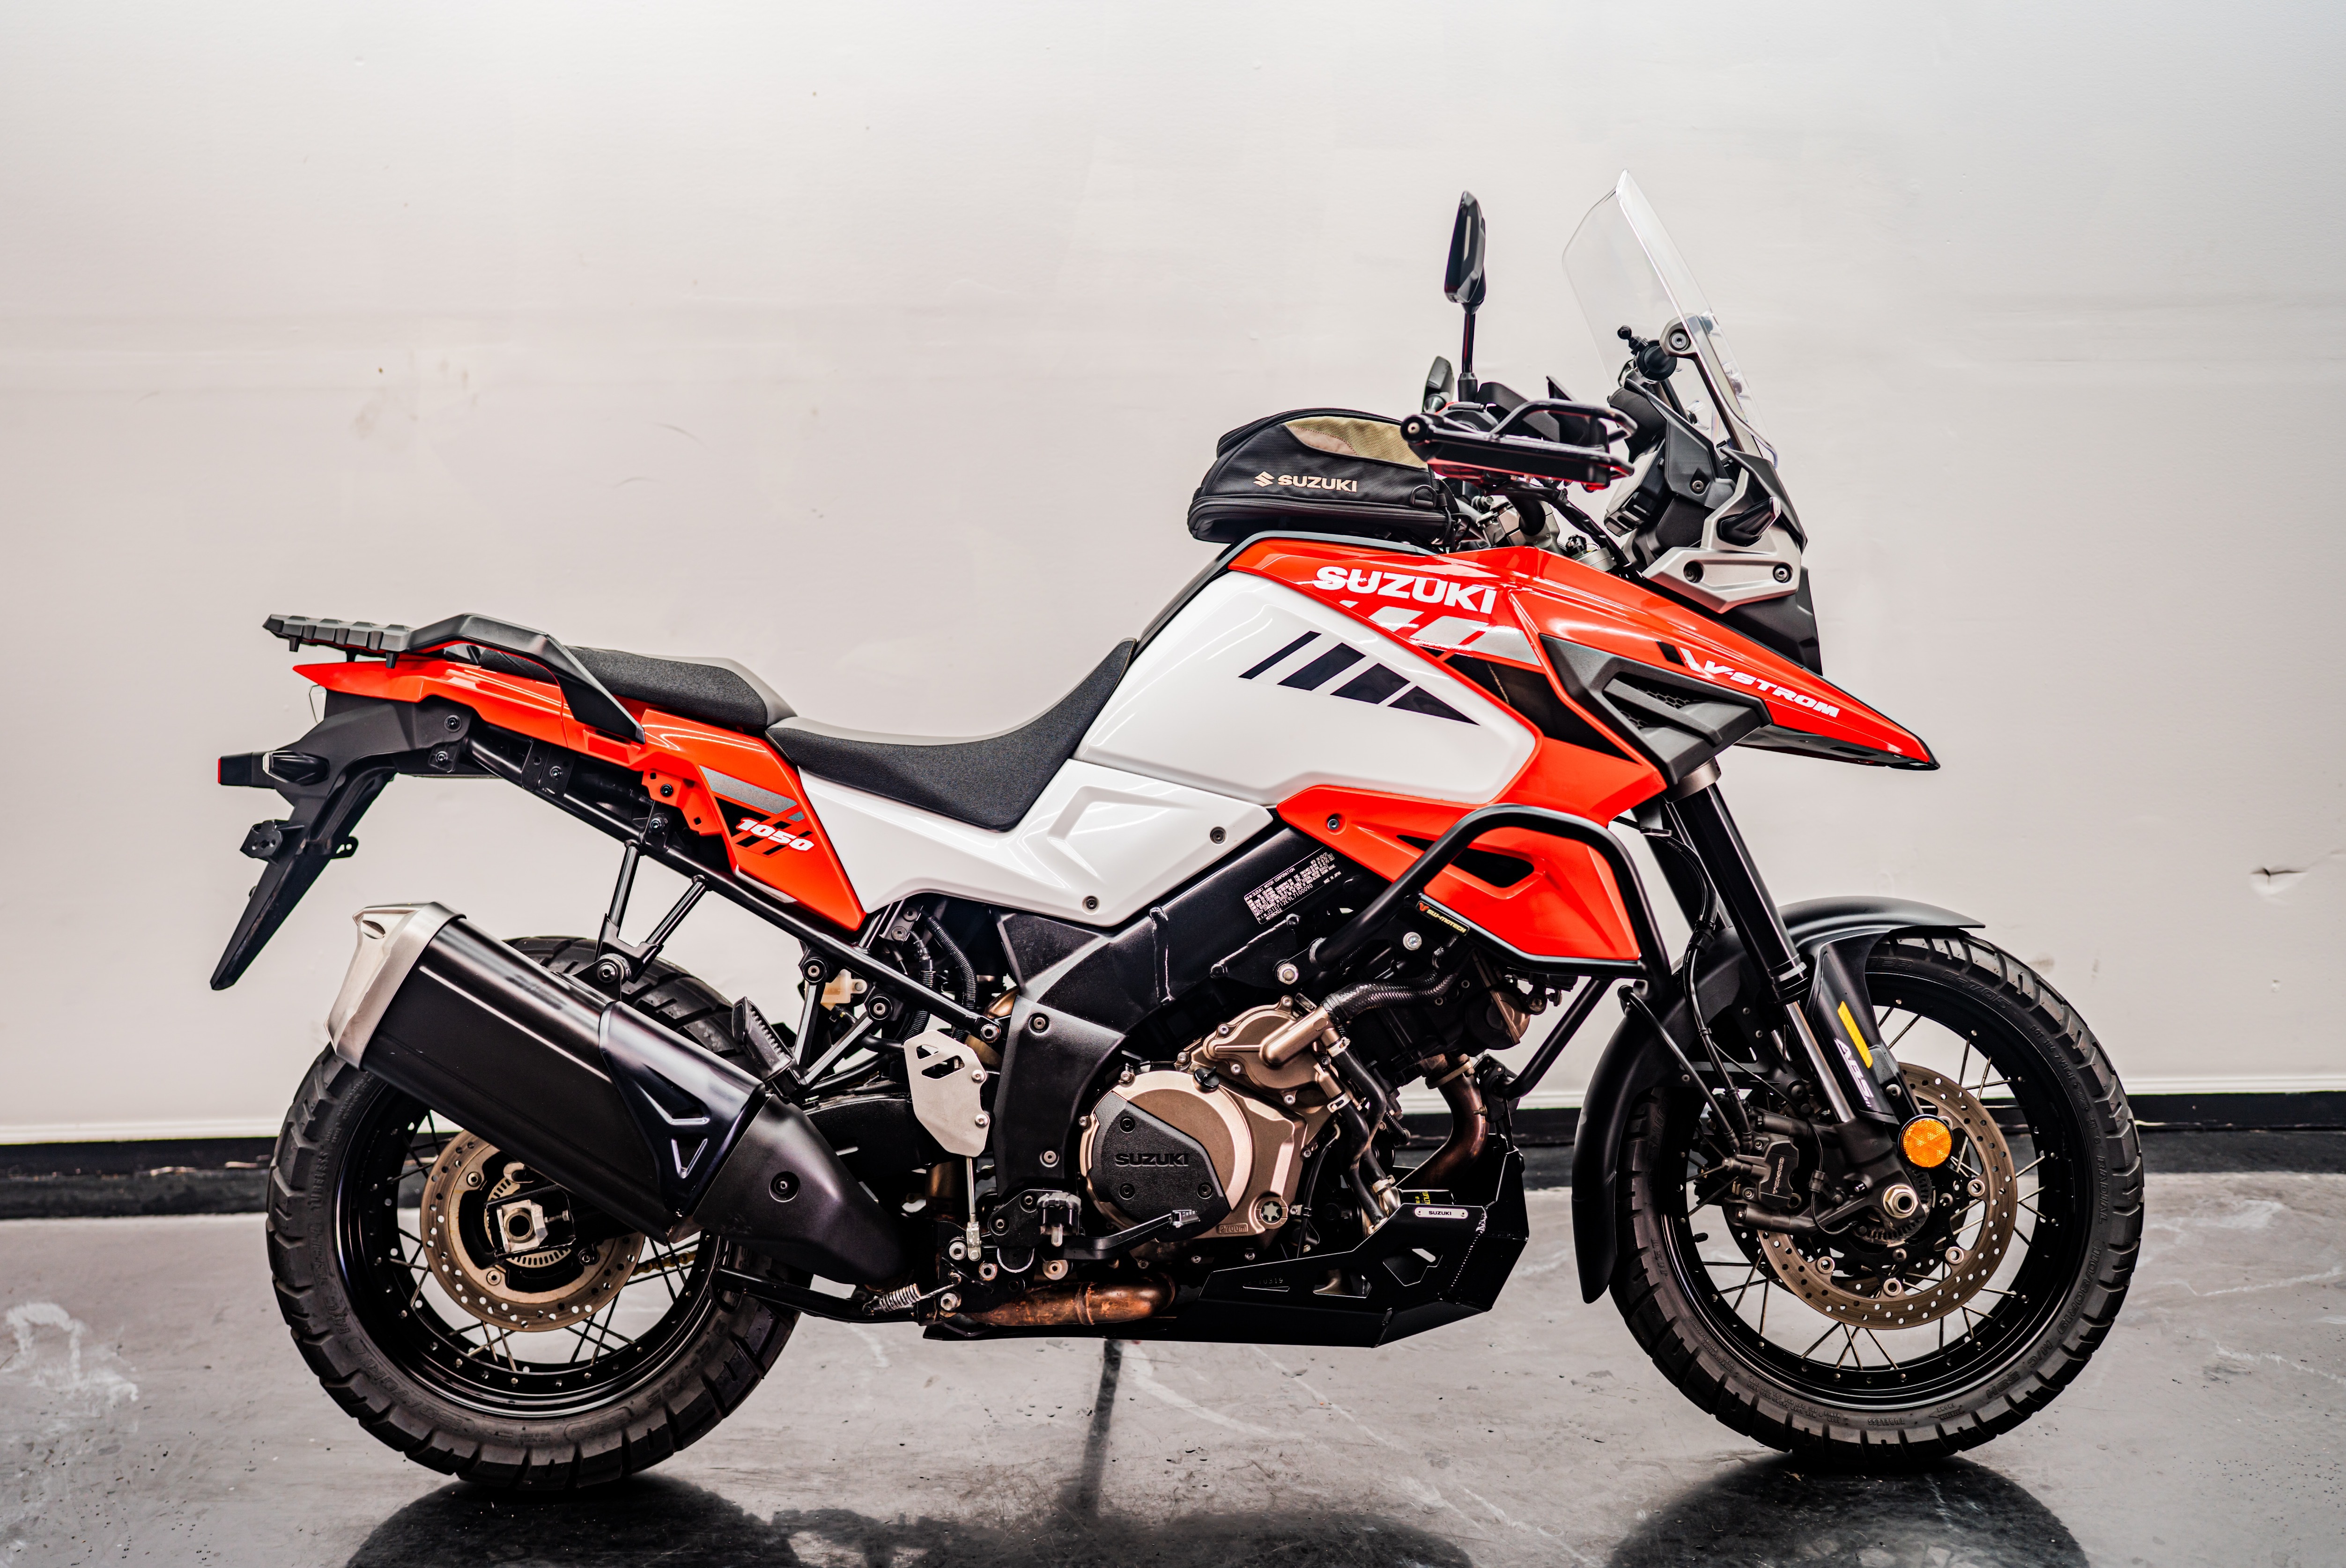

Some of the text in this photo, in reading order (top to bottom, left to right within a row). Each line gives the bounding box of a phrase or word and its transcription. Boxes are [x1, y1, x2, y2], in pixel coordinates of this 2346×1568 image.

[1278, 474, 1358, 493] SUZUKI
[1314, 566, 1498, 614] SUZUKI
[1703, 659, 1840, 718] V-STROM
[737, 818, 814, 851] 1050
[1263, 880, 1274, 889] MOTOR
[1274, 867, 1295, 882] CORPORATION
[1427, 909, 1466, 933] SW-MOTECH
[1939, 969, 2011, 1010] E-705
[2028, 1024, 2044, 1039] DOT
[1835, 1038, 1874, 1098] ABS
[1646, 1095, 1673, 1161] SHIN
[1115, 1153, 1189, 1167] SUZUKI
[1773, 1157, 1784, 1194] TOKICO
[309, 1150, 330, 1211] TUBELESS
[2095, 1154, 2108, 1224] RADIAL
[1651, 1238, 1668, 1276] MST
[1984, 1246, 2102, 1399] 110/80R19 M/C 59H
[1867, 1417, 1905, 1425] TUBELESS
[1936, 1402, 1955, 1413] FRONT
[1939, 1408, 1962, 1420] ROTATION
